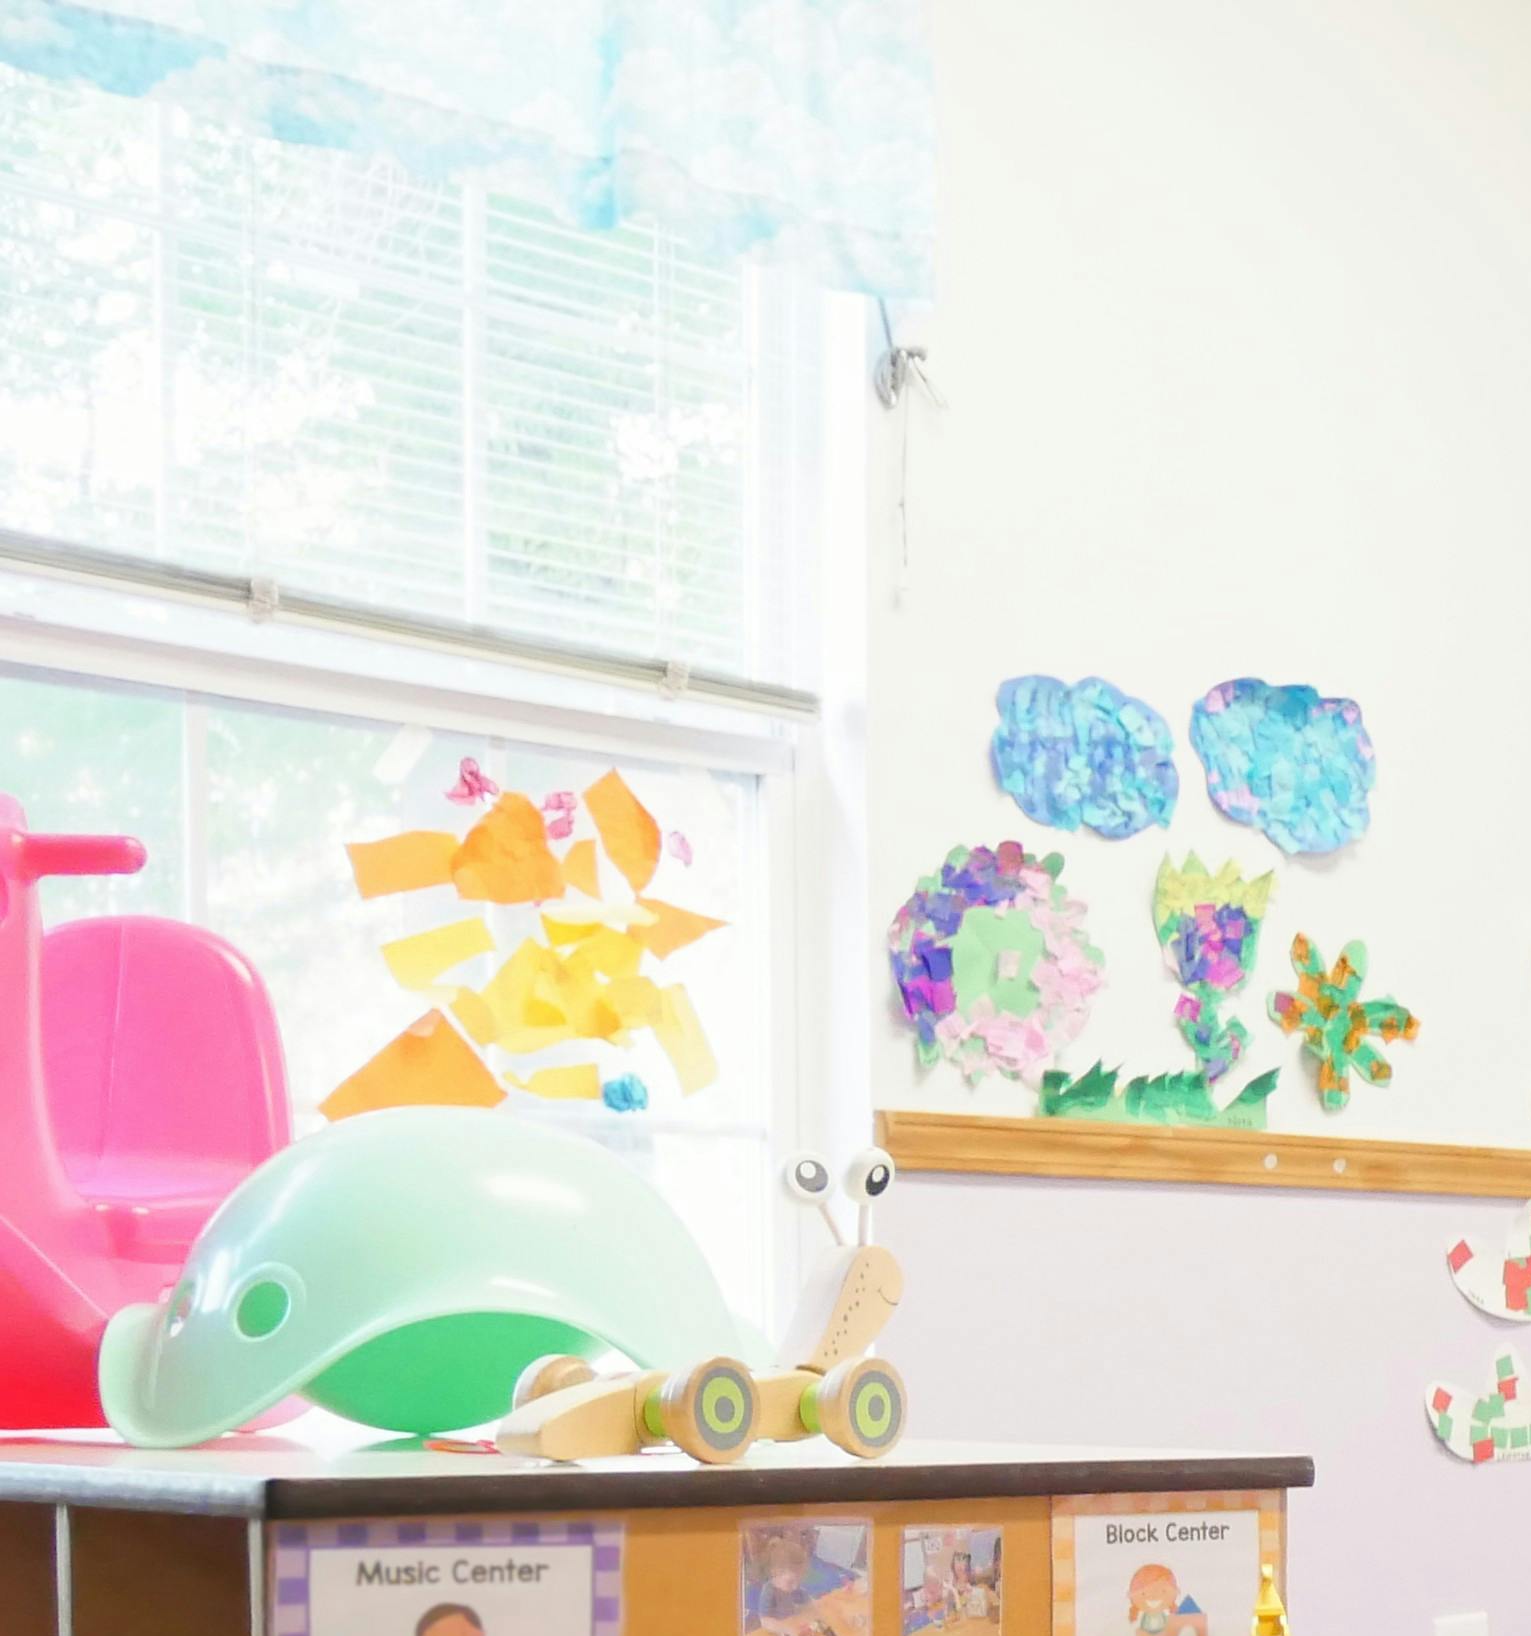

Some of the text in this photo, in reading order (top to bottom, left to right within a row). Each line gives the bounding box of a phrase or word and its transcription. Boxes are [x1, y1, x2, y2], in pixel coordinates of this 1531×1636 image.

[1106, 1520, 1230, 1545] Block Center
[355, 1557, 550, 1587] Music Center
